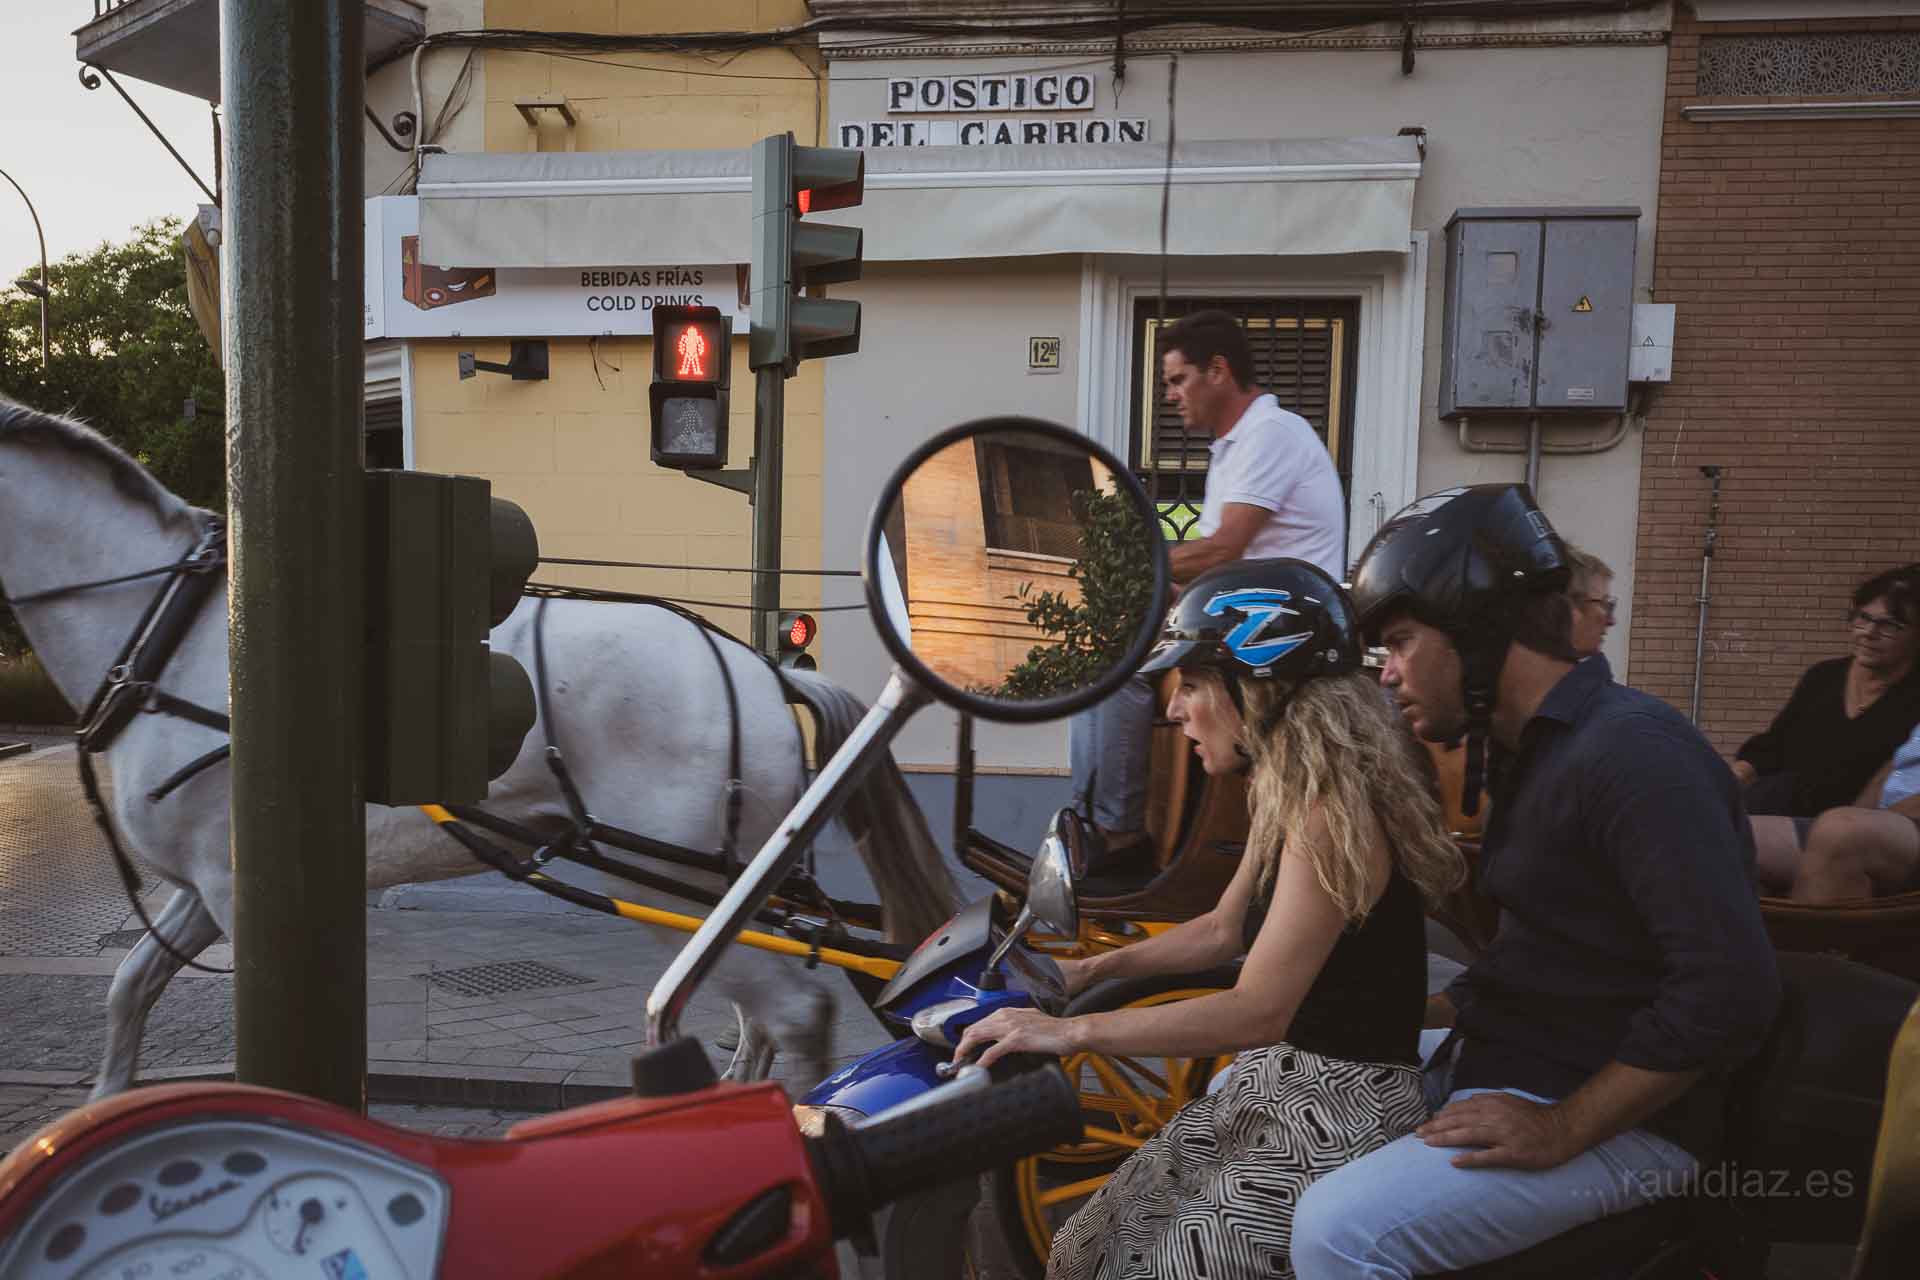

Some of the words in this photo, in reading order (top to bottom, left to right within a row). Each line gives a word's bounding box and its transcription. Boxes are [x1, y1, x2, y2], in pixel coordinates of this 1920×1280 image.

[890, 76, 1090, 109] POSTIGO
[840, 123, 925, 147] DEL
[581, 271, 651, 287] BEBIDAS
[656, 265, 704, 286] FRÍAS
[586, 296, 636, 311] COLD
[642, 295, 704, 310] DRINKS
